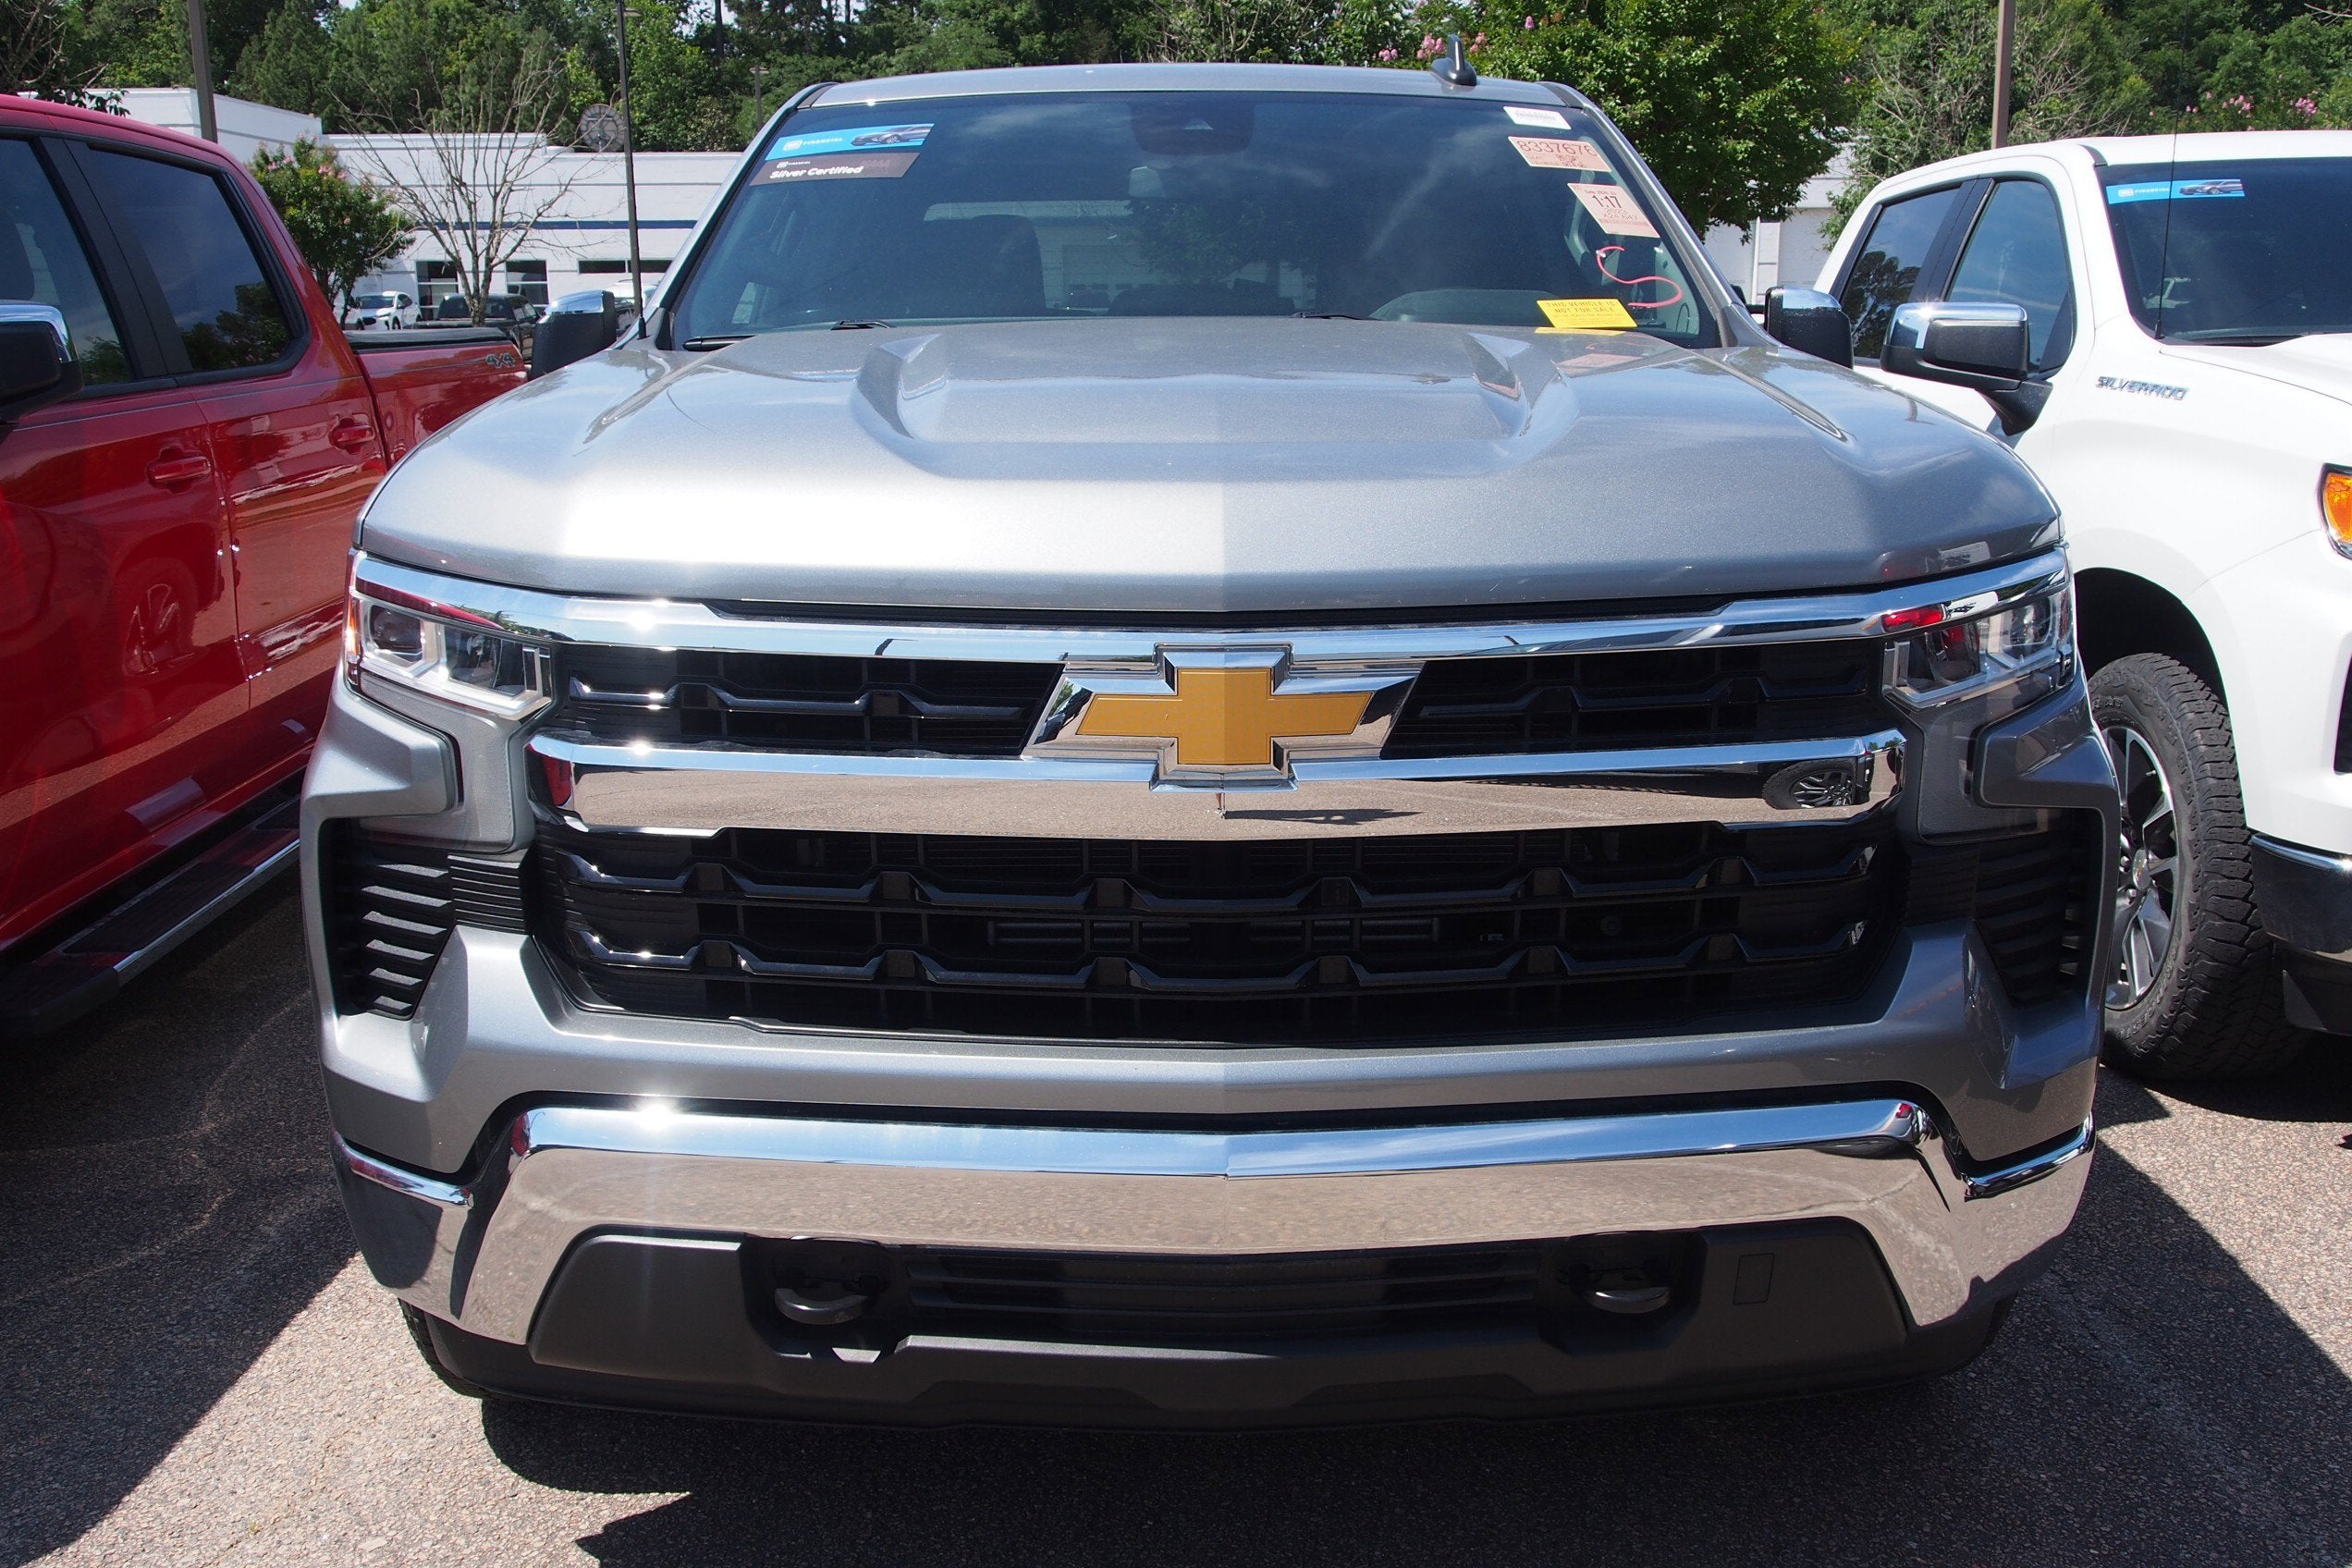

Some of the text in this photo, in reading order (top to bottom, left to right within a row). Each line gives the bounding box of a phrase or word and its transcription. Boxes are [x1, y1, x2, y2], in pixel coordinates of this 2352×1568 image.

[1516, 141, 1598, 156] 8337676
[769, 165, 864, 179] Silver Certified
[1592, 195, 1622, 209] 1:17
[2096, 376, 2189, 400] SILVERADO
